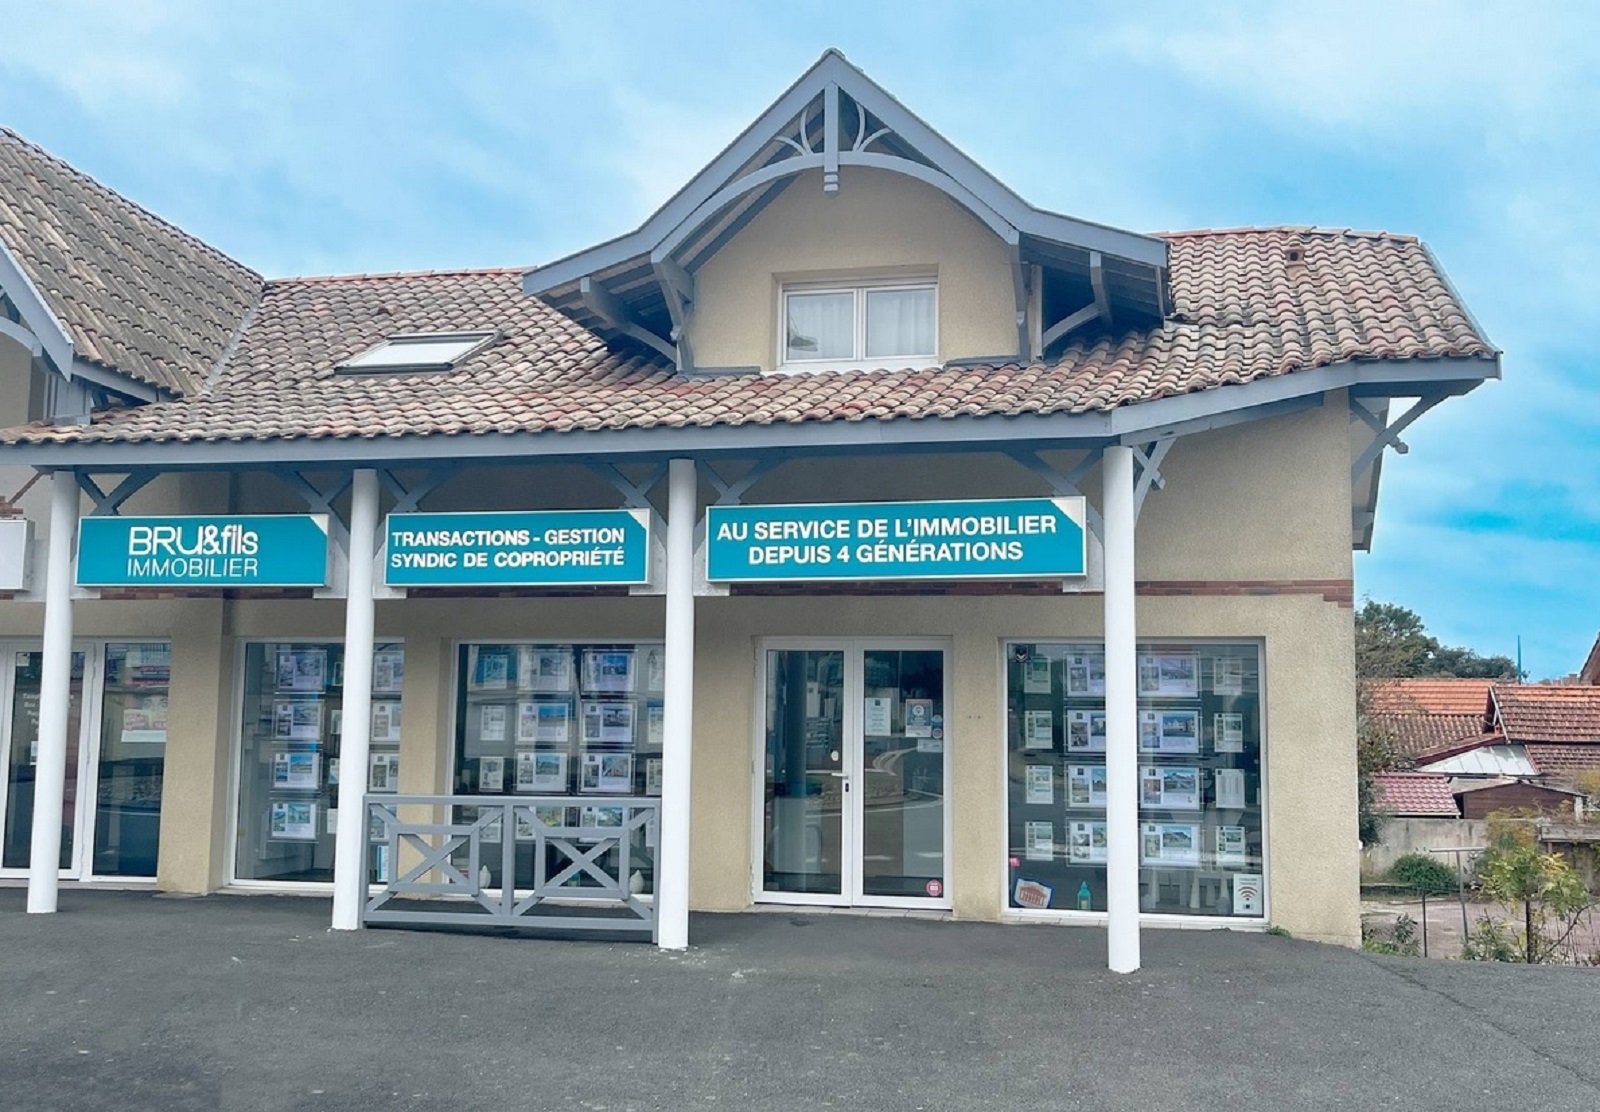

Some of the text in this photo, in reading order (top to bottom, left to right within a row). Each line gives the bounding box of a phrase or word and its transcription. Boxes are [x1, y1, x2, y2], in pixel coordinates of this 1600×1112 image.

[391, 530, 530, 548] TRANSACTIONS
[544, 527, 625, 545] GESTION
[717, 515, 1056, 541] AU SERVICE DE L'IMMOBILIER
[391, 546, 625, 568] SYNDIC DE COPROPRIÉTÉ
[749, 538, 1024, 565] DEPUIS 4 GÉNÉRATIONS
[127, 558, 258, 577] IMMOBILIER
